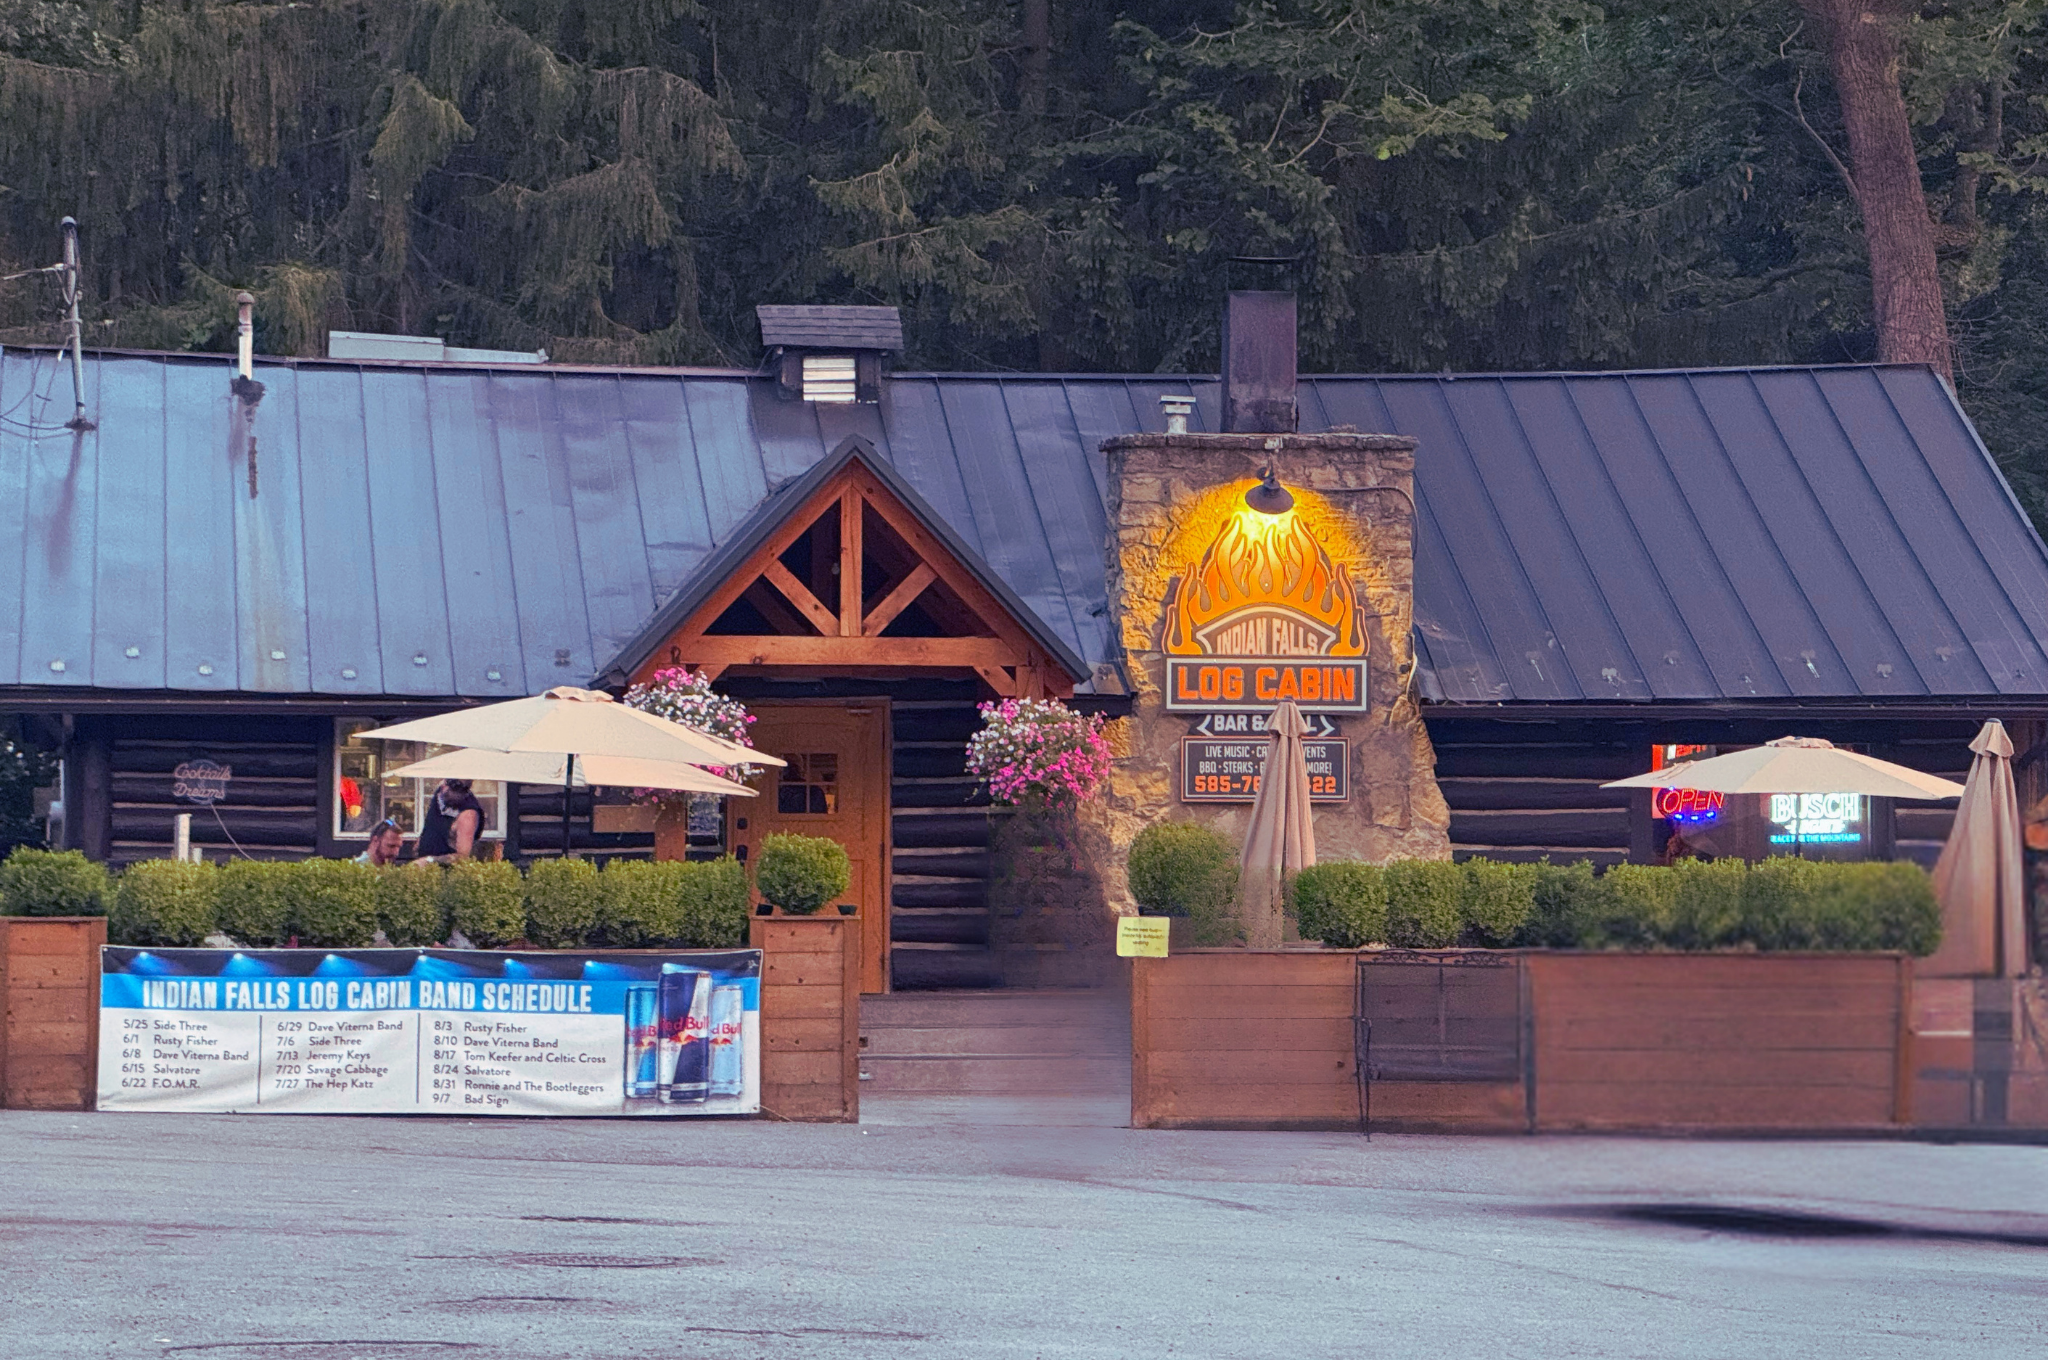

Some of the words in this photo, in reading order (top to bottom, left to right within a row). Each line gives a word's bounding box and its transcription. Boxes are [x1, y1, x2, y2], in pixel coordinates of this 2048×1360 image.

[1217, 617, 1267, 655] INDIAN
[1272, 617, 1318, 656] FALLS
[1177, 666, 1244, 700] LOG
[1255, 667, 1356, 701] CABIN
[1214, 714, 1248, 732] BAR
[1251, 714, 1266, 732] &
[1205, 746, 1222, 758] LIVE
[1224, 746, 1250, 758] MUSIC
[1199, 762, 1217, 774] BBQ
[1222, 762, 1254, 774] STEAKS
[173, 783, 226, 799] Dreams
[1663, 788, 1725, 814] OPEN
[1770, 793, 1860, 823] BUSCH
[142, 980, 218, 1009] INDIAN
[225, 981, 291, 1010] FALLS
[298, 981, 339, 1010] LOG
[346, 981, 411, 1010] CABIN
[419, 981, 476, 1010] BAND
[482, 982, 593, 1013] SCHEDULE
[123, 1018, 149, 1030] 5/25
[153, 1020, 176, 1031] Side
[179, 1020, 208, 1032] Three
[277, 1021, 303, 1032] 6/29
[308, 1022, 334, 1032] Dave
[337, 1022, 374, 1032] Viterna
[377, 1020, 404, 1031] Band
[434, 1021, 453, 1031] 8/3
[464, 1022, 493, 1035] Rusty
[496, 1023, 528, 1034] Fisher
[685, 1016, 709, 1030] Bull
[123, 1034, 140, 1044] 6/1
[153, 1034, 183, 1047] Rusty
[186, 1035, 218, 1046] Fisher
[277, 1036, 295, 1046] 7/6
[308, 1036, 331, 1047] Side
[334, 1036, 362, 1046] Three
[434, 1035, 458, 1046] 8/10
[464, 1037, 490, 1047] Dave
[492, 1037, 531, 1048] Viterna
[533, 1038, 559, 1049] Band
[122, 1048, 141, 1059] 6/8
[153, 1050, 179, 1060] Dave
[182, 1050, 220, 1061] Viterna
[223, 1051, 250, 1061] Band
[276, 1050, 299, 1061] 7/13
[306, 1051, 343, 1063] Jeremy
[346, 1050, 371, 1063] Keys
[433, 1050, 457, 1060] 8/17
[464, 1051, 486, 1062] Tom
[488, 1051, 522, 1062] Keefer
[524, 1052, 543, 1063] and
[545, 1052, 576, 1063] Celtic
[578, 1054, 607, 1064] Cross
[121, 1063, 145, 1074] 6/15
[153, 1064, 201, 1075] Salvatore
[275, 1064, 301, 1075] 7/20
[307, 1065, 342, 1078] Savage
[344, 1064, 389, 1078] Cabbage
[433, 1065, 459, 1075] 8/24
[464, 1066, 512, 1077] Salvatore
[121, 1078, 147, 1089] 6/22
[152, 1078, 201, 1089] F.O.M.R.
[275, 1079, 299, 1089] 7/27
[305, 1079, 324, 1089] The
[326, 1079, 348, 1092] Hep
[350, 1079, 374, 1089] Katz
[433, 1079, 456, 1090] 8/31
[464, 1080, 501, 1091] Ronnie
[502, 1081, 522, 1092] and
[524, 1081, 543, 1092] The
[545, 1082, 605, 1096] Bootleggers
[432, 1093, 451, 1104] 9/7
[464, 1095, 484, 1105] Bad
[486, 1095, 509, 1108] Sign
